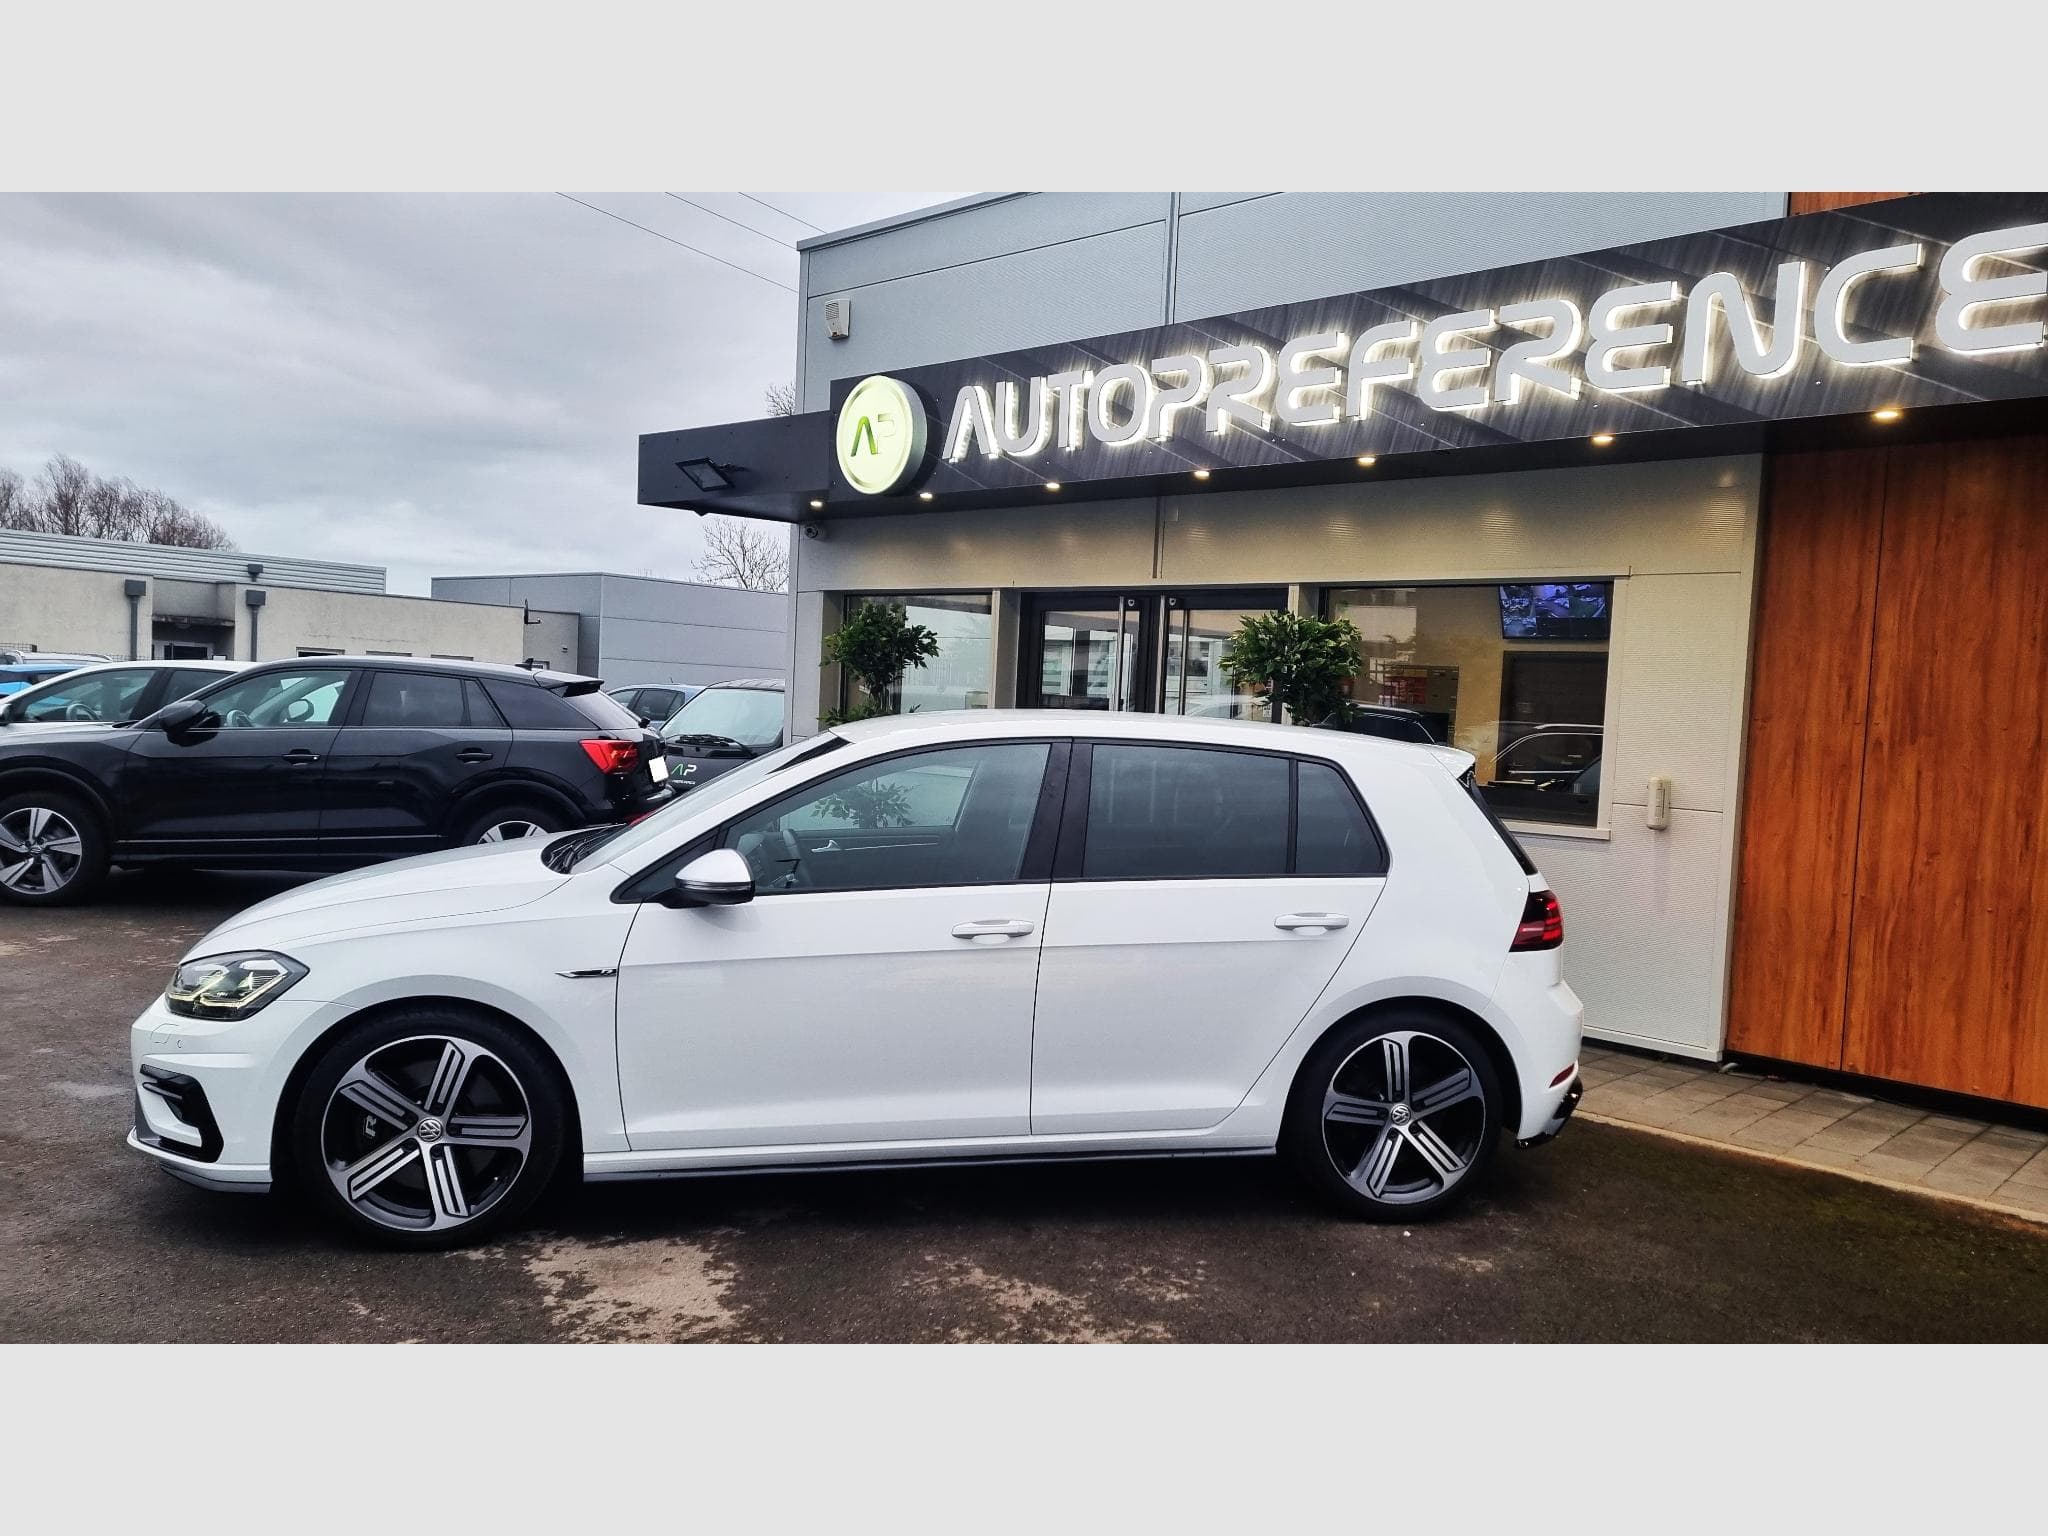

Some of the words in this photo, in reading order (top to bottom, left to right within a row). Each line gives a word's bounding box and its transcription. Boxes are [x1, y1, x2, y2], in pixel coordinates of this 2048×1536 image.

[942, 222, 2048, 461] AUTOPREFERENCE
[850, 413, 897, 457] AP
[671, 763, 697, 776] AP
